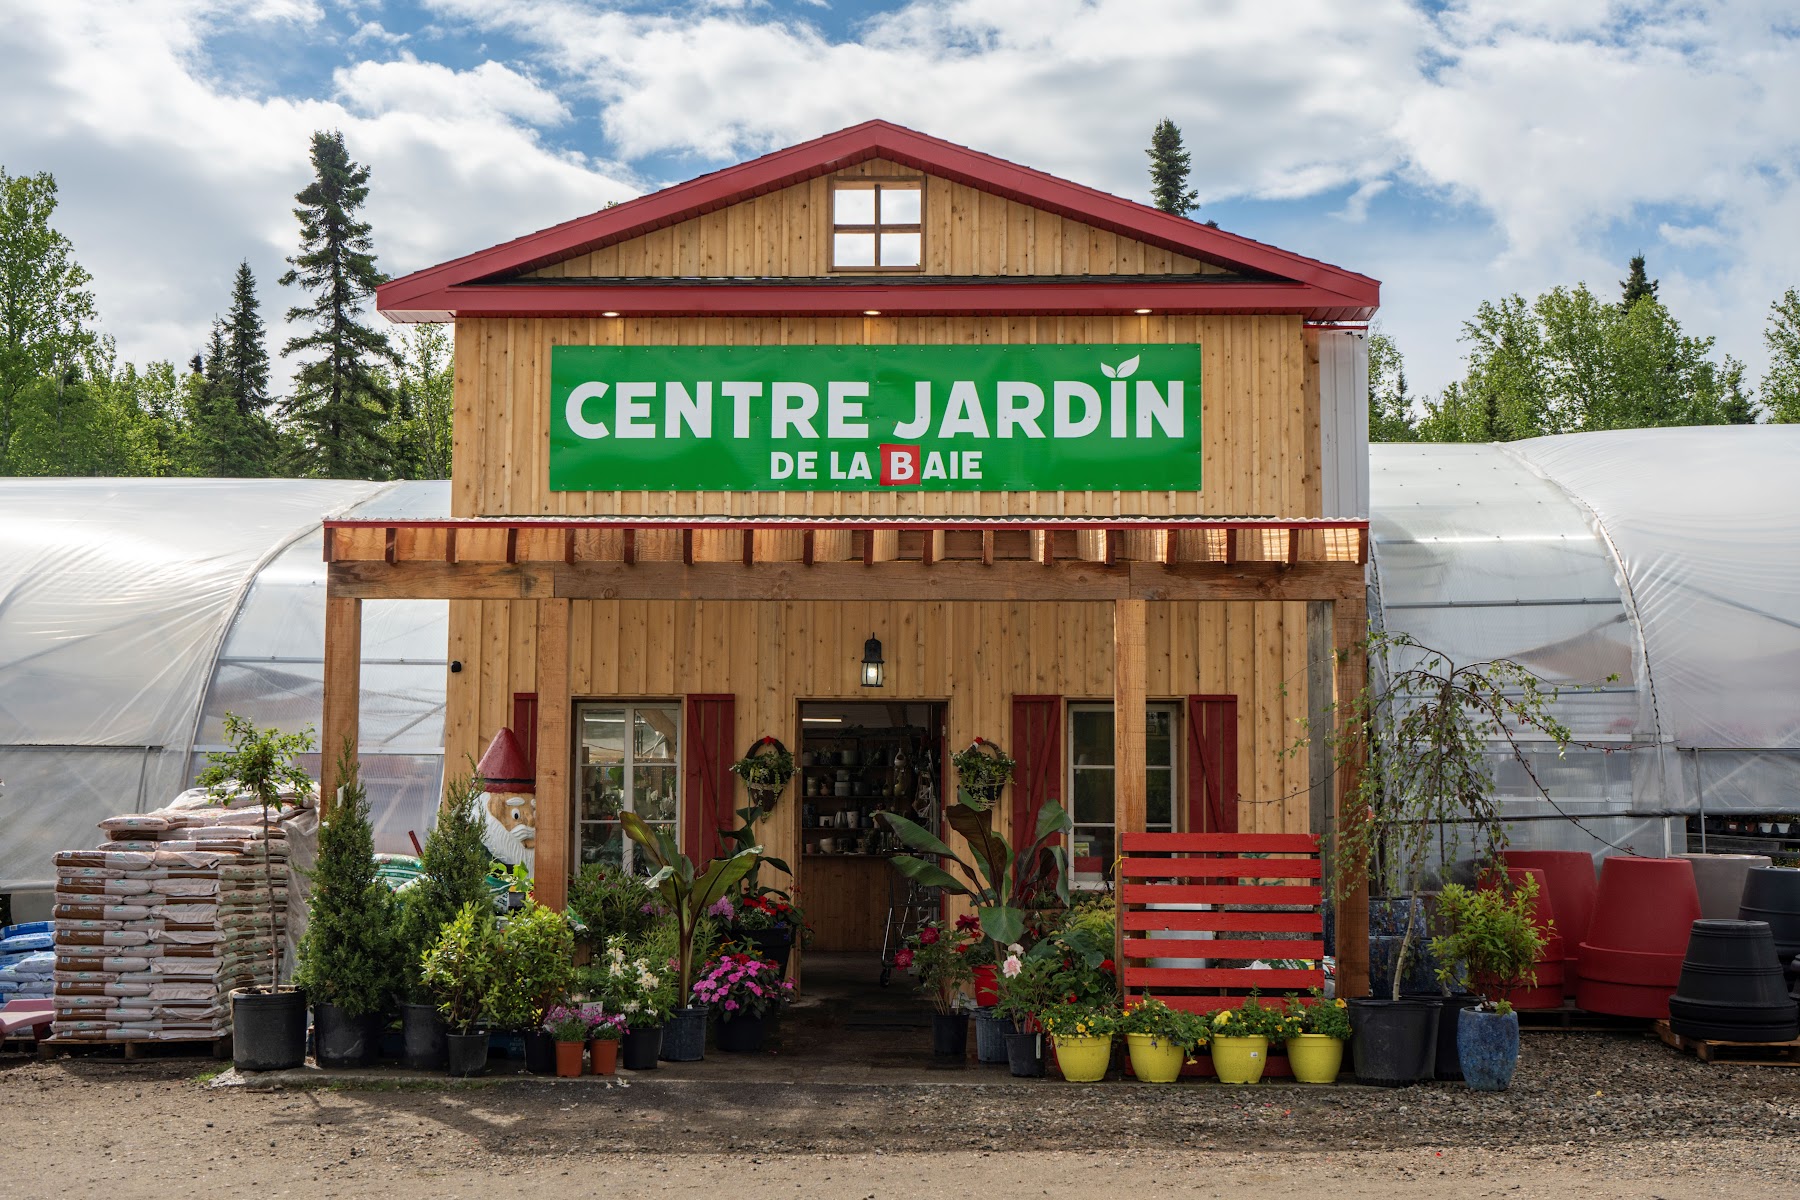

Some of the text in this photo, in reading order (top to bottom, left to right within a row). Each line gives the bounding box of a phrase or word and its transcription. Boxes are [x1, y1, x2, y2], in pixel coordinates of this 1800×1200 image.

[565, 381, 1184, 439] CENTRE JARDIN
[770, 451, 983, 480] DE LA BAIE
